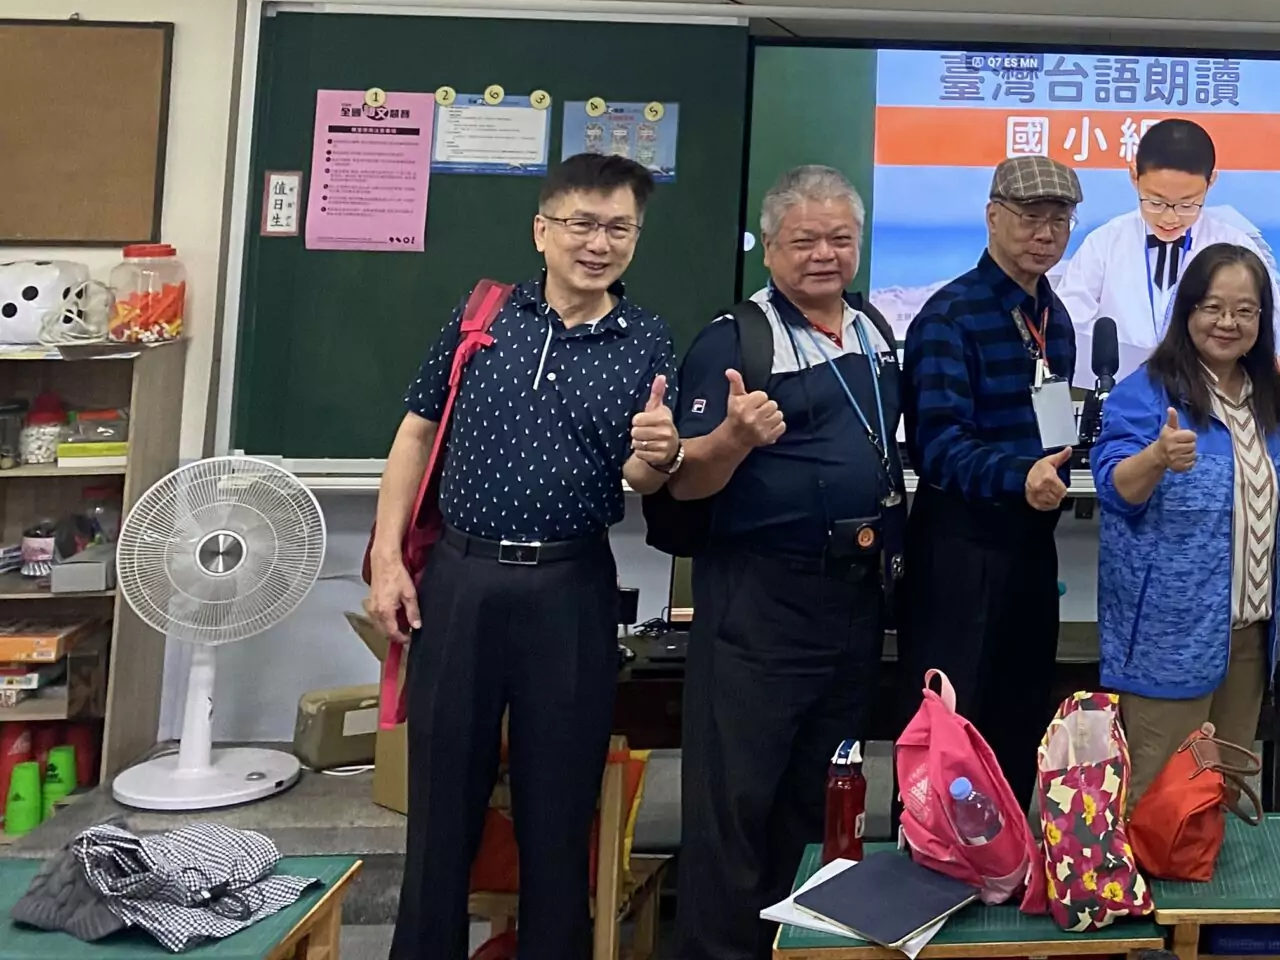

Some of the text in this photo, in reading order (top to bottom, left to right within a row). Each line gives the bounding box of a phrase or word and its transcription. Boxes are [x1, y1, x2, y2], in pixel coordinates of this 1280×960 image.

[987, 58, 1038, 68] Q7 ES MN
[939, 52, 1240, 106] 臺灣台語朗讀
[441, 90, 450, 100] 2
[536, 95, 546, 105] 3
[269, 180, 288, 228] 值日生
